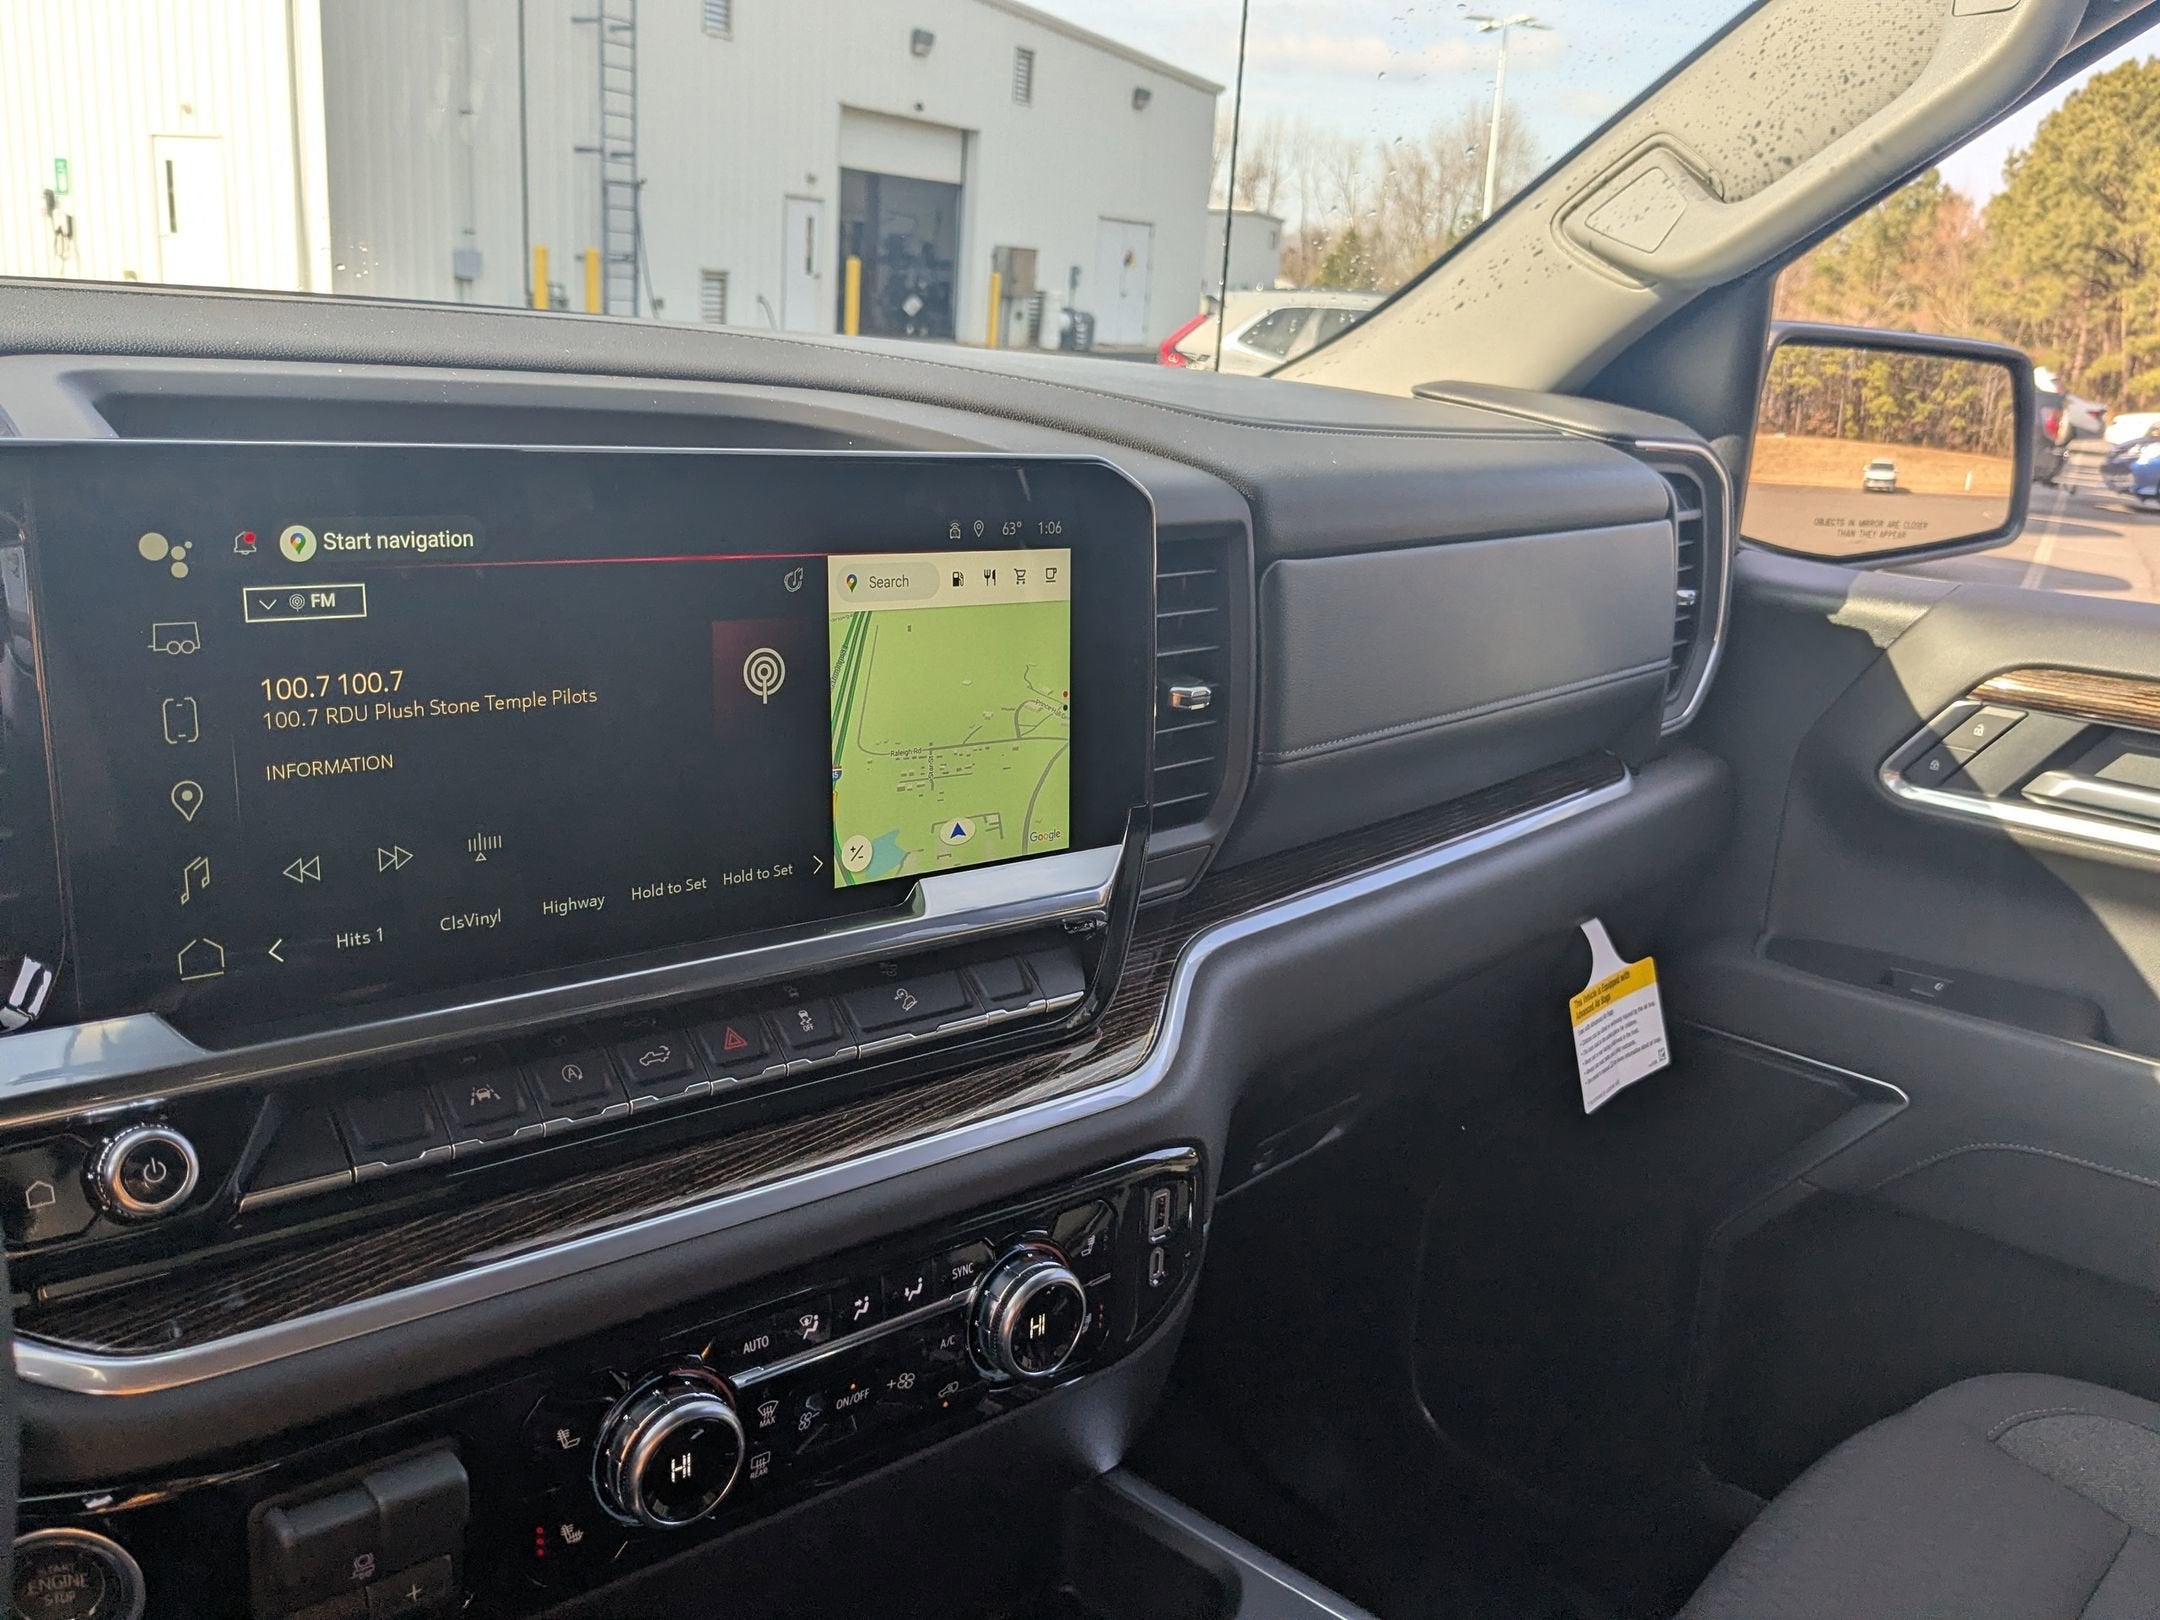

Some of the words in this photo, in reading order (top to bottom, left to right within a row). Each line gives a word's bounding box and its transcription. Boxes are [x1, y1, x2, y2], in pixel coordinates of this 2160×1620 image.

[1038, 521, 1062, 535] 1:06
[1814, 518, 1845, 528] OBJECTS
[1848, 519, 1855, 527] IN
[1859, 519, 1884, 528] MIRROR
[1887, 520, 1900, 529] ARE
[1903, 520, 1928, 530] CLOSER
[1838, 528, 1856, 538] THAN
[1860, 529, 1876, 538] THEY
[1879, 530, 1907, 539] APPEAR
[323, 532, 371, 551] Start
[377, 530, 474, 553] navigation
[868, 574, 910, 589] Search
[310, 593, 336, 609] FM
[261, 674, 330, 701] 100.7
[338, 670, 403, 696] 100.7
[263, 708, 318, 730] 100.7
[326, 704, 368, 725] RDU
[375, 700, 425, 721] Plush
[429, 699, 480, 716] Stone
[484, 690, 547, 713] Temple
[552, 687, 598, 706] Pilots
[890, 748, 912, 758] Raleigh
[266, 753, 394, 782] INFORMATION
[1030, 828, 1061, 842] Google
[723, 868, 753, 886] Hold
[757, 867, 770, 881] to
[773, 863, 793, 879] Set
[631, 882, 664, 901] Hold
[667, 882, 682, 896] to
[686, 877, 707, 893] Set
[543, 895, 605, 917] Highway
[440, 908, 502, 931] ClsVinyl
[336, 931, 371, 949] Hits
[376, 927, 384, 942] 1
[952, 1262, 974, 1280] SYNC
[1029, 1313, 1046, 1339] HI
[743, 1335, 770, 1355] AUTO
[940, 1334, 956, 1350] A/C
[836, 1388, 870, 1410] ON/OFF
[760, 1416, 776, 1428] MAX
[671, 1452, 691, 1484] HI
[750, 1466, 768, 1480] REAR
[27, 1573, 89, 1596] ENGINE
